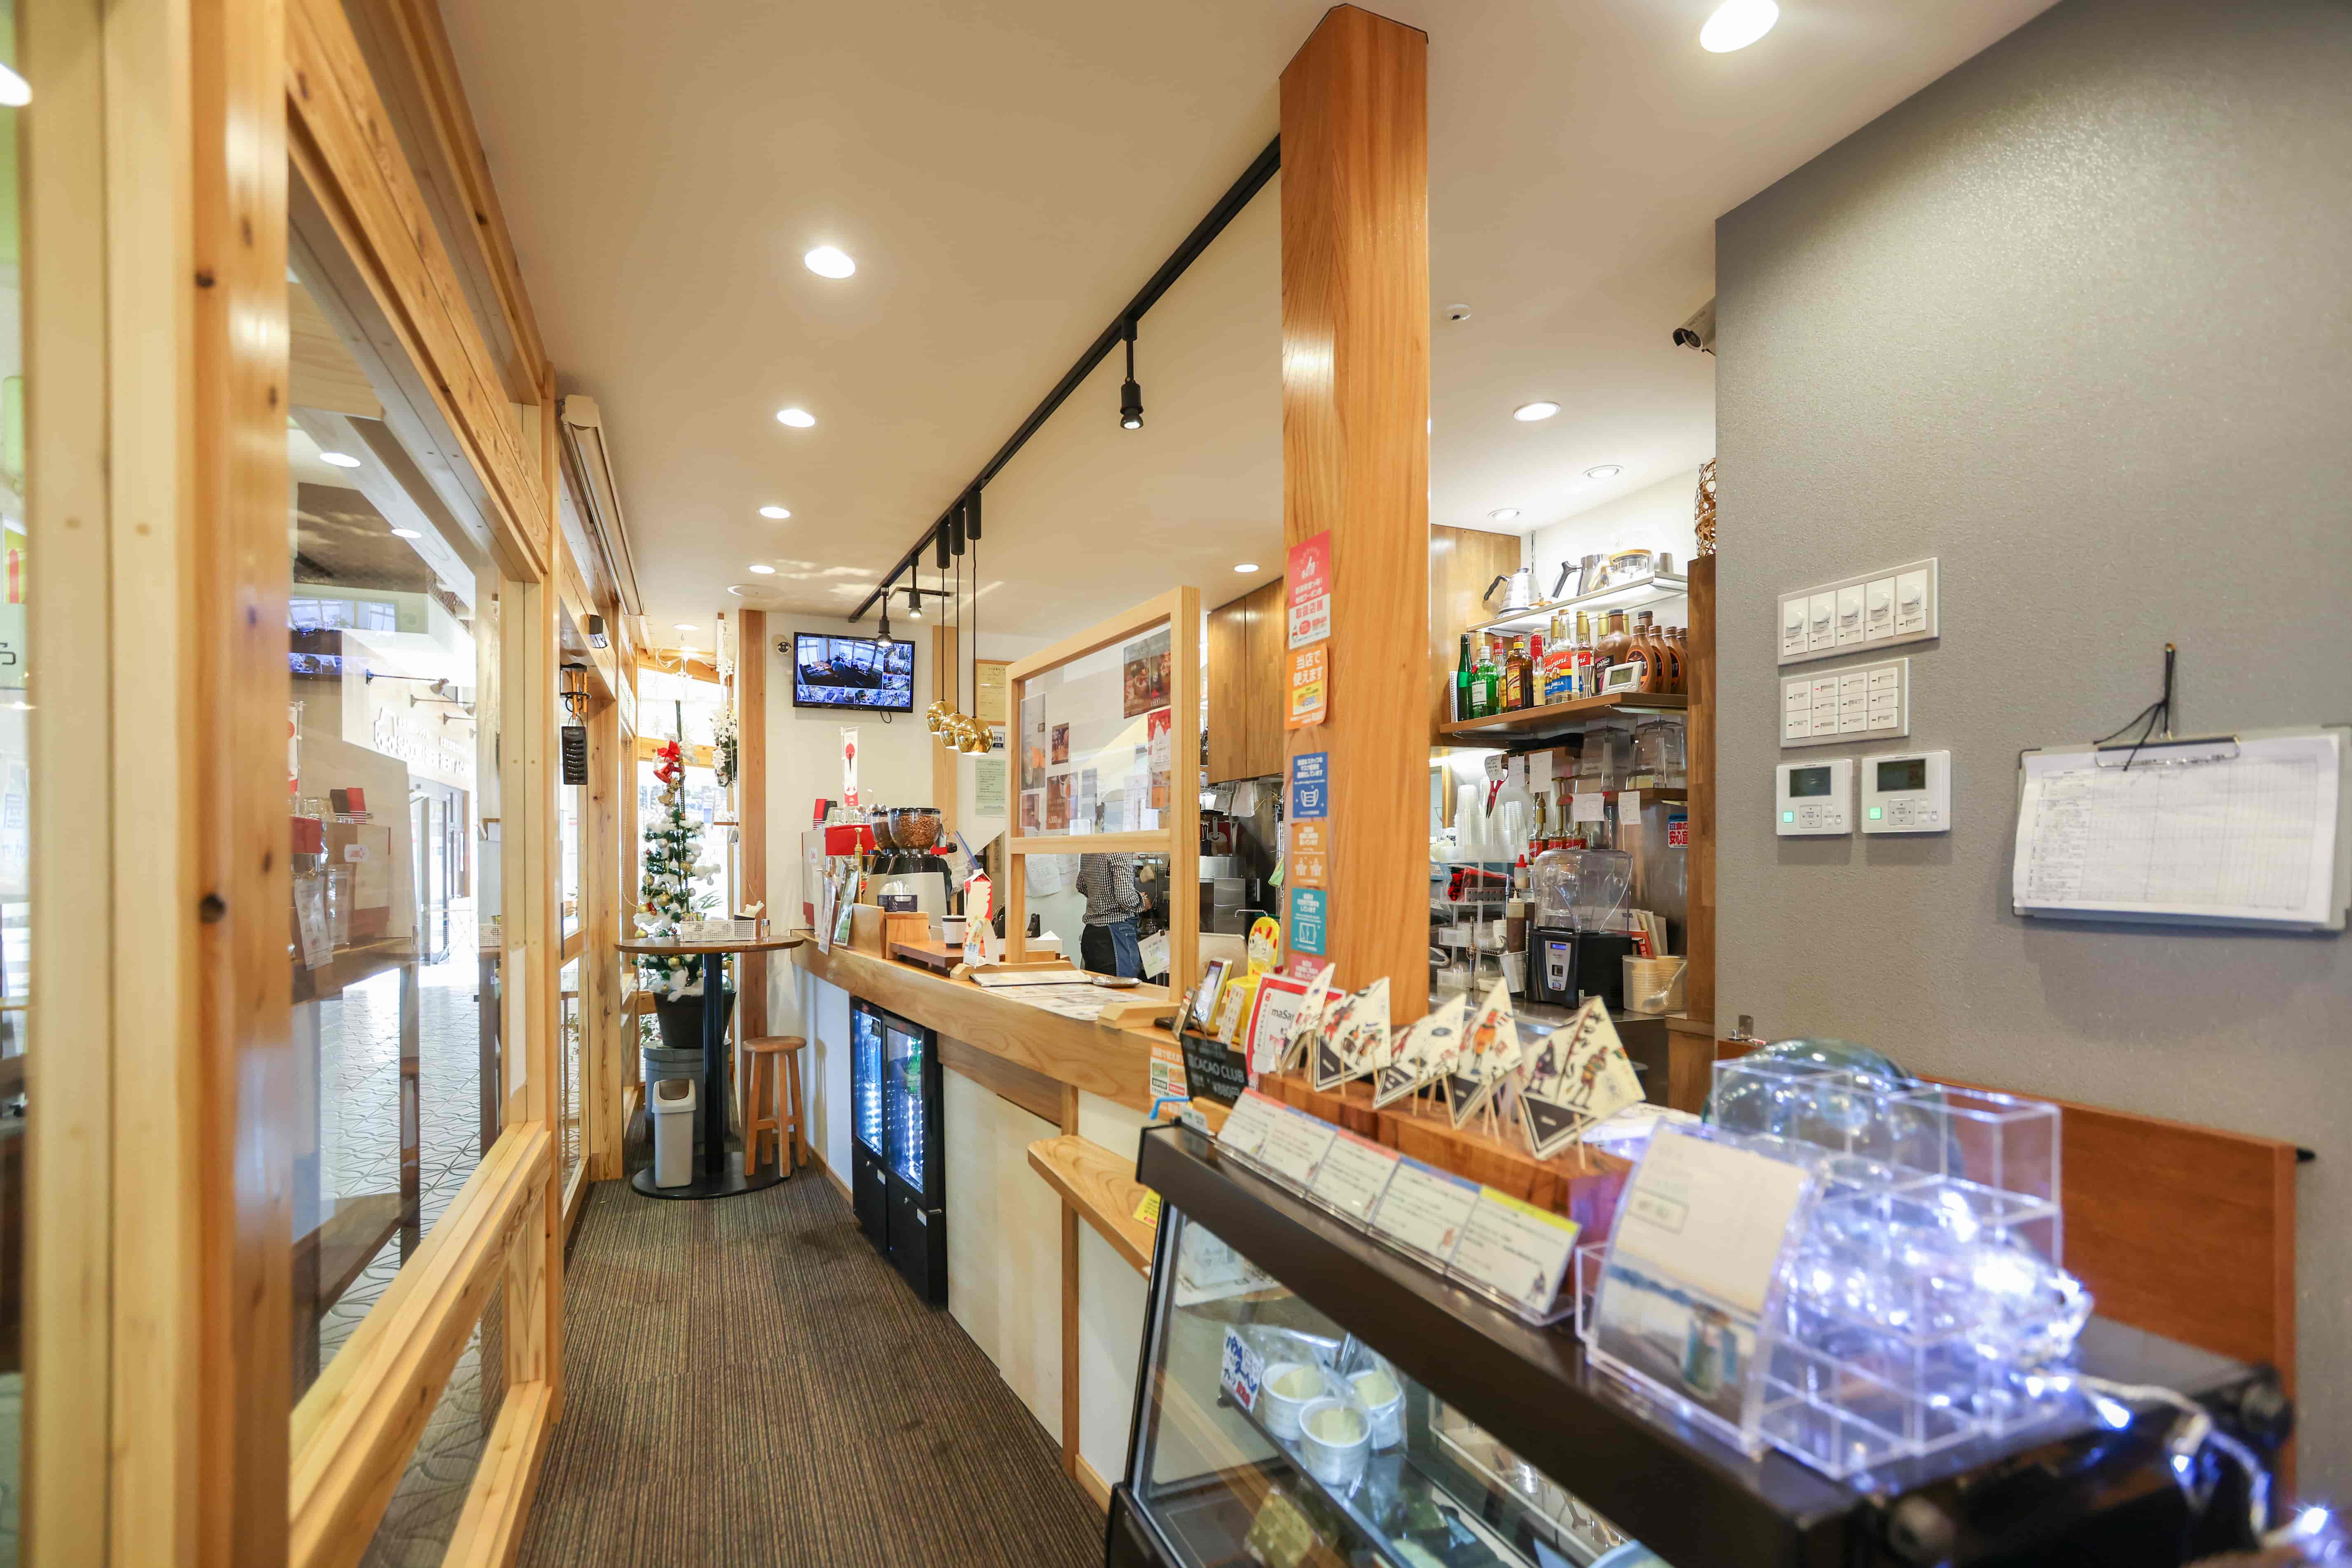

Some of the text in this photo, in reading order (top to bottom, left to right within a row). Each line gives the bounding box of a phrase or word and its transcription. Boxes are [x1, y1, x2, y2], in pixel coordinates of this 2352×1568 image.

[1295, 650, 1321, 670] 当店で
[1293, 666, 1324, 687] 使えます
[1220, 1065, 1245, 1083] CLUB
